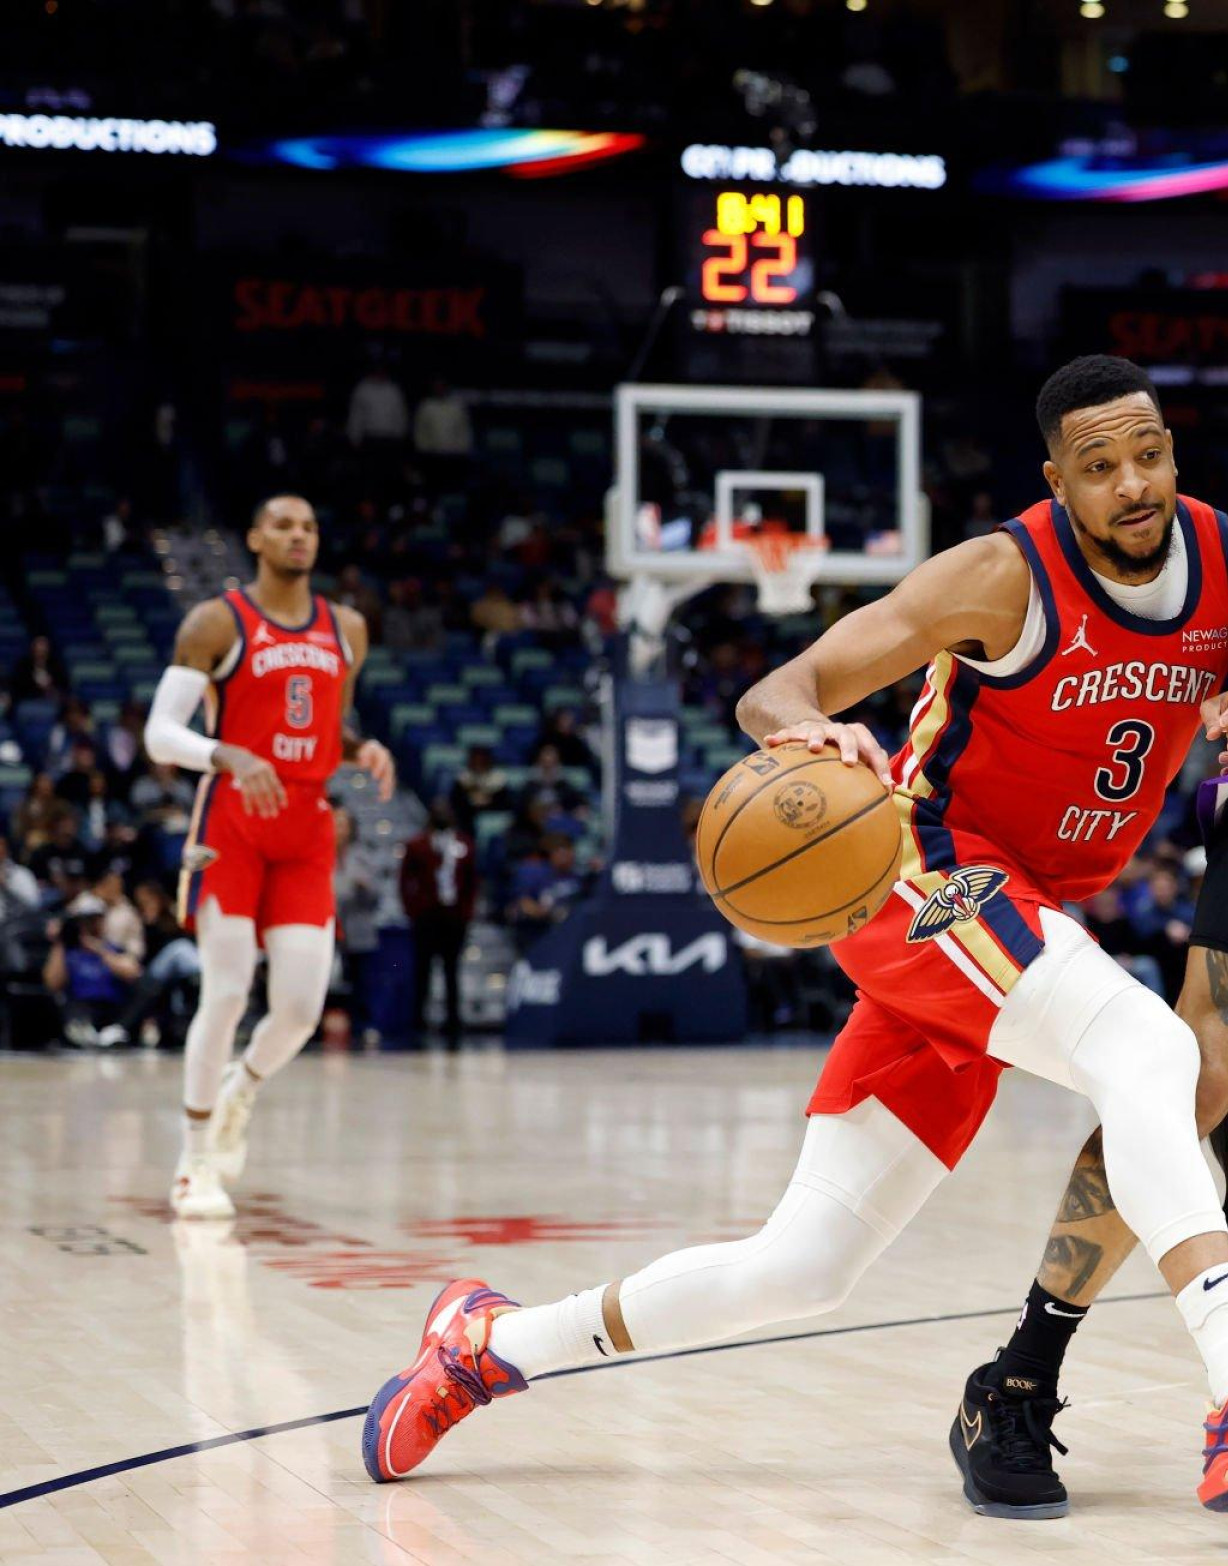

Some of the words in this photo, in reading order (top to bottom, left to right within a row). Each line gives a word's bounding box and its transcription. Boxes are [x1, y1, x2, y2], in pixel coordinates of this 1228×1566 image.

[702, 228, 797, 304] 22
[235, 277, 488, 337] SEATGEEK
[251, 642, 340, 678] CRESCENT
[1051, 661, 1216, 711] CRESCENT
[285, 674, 313, 729] 5
[271, 732, 318, 762] CITY
[1094, 718, 1155, 802] 3
[1056, 805, 1137, 842] CITY
